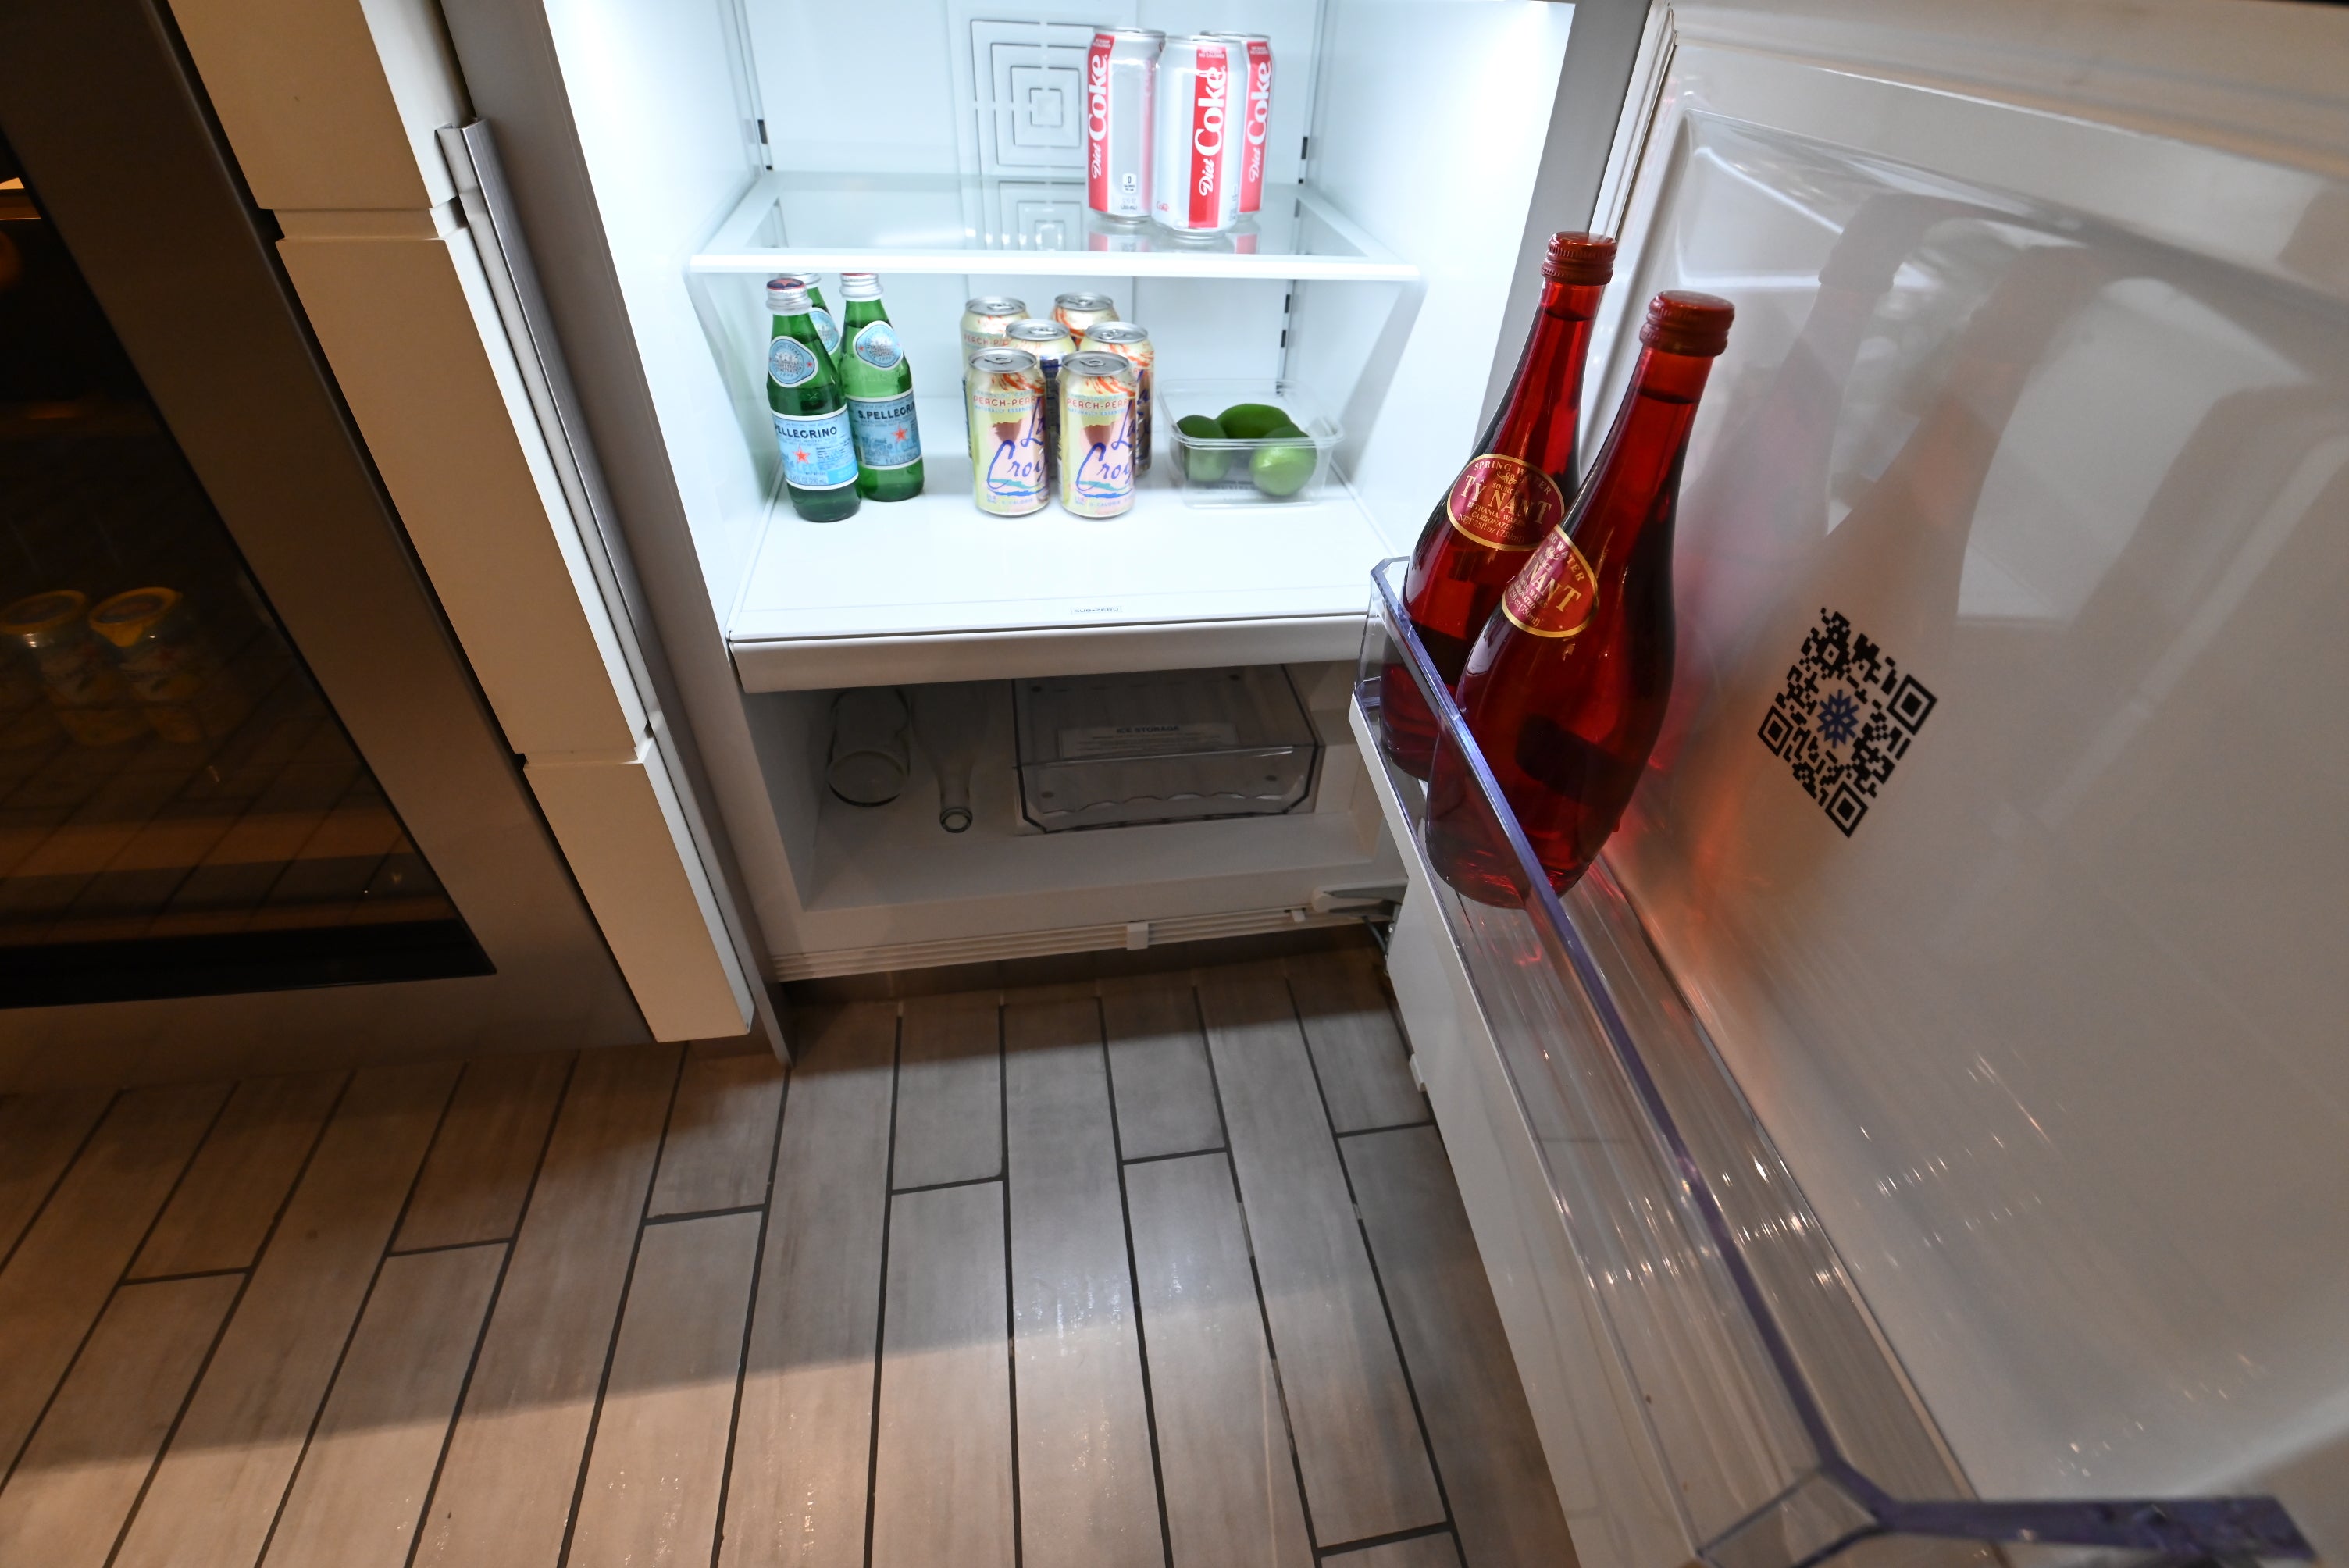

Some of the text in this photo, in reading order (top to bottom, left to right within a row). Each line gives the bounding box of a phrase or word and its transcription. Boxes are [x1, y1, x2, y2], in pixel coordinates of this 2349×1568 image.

[1089, 55, 1108, 141] Coke
[1195, 66, 1225, 156] Coke
[1247, 62, 1271, 145] Coke
[1091, 143, 1102, 179] Diet
[1198, 159, 1214, 196] Diet
[1249, 148, 1261, 183] Diet
[858, 400, 914, 419] S.PELLEGRIN
[973, 394, 1036, 407] PEACH-PEAR
[1474, 461, 1512, 472] SPRING
[1488, 489, 1552, 524] NANT
[1492, 482, 1519, 497] SOURCE
[1458, 514, 1474, 525] NET
[1496, 529, 1524, 543] (750ml)
[1467, 501, 1526, 528] BETHANIA, WAL
[1471, 511, 1515, 531] CARBONATED
[1556, 540, 1584, 582] WATER
[1527, 561, 1581, 612] NANT
[1518, 603, 1540, 627] (750ml)
